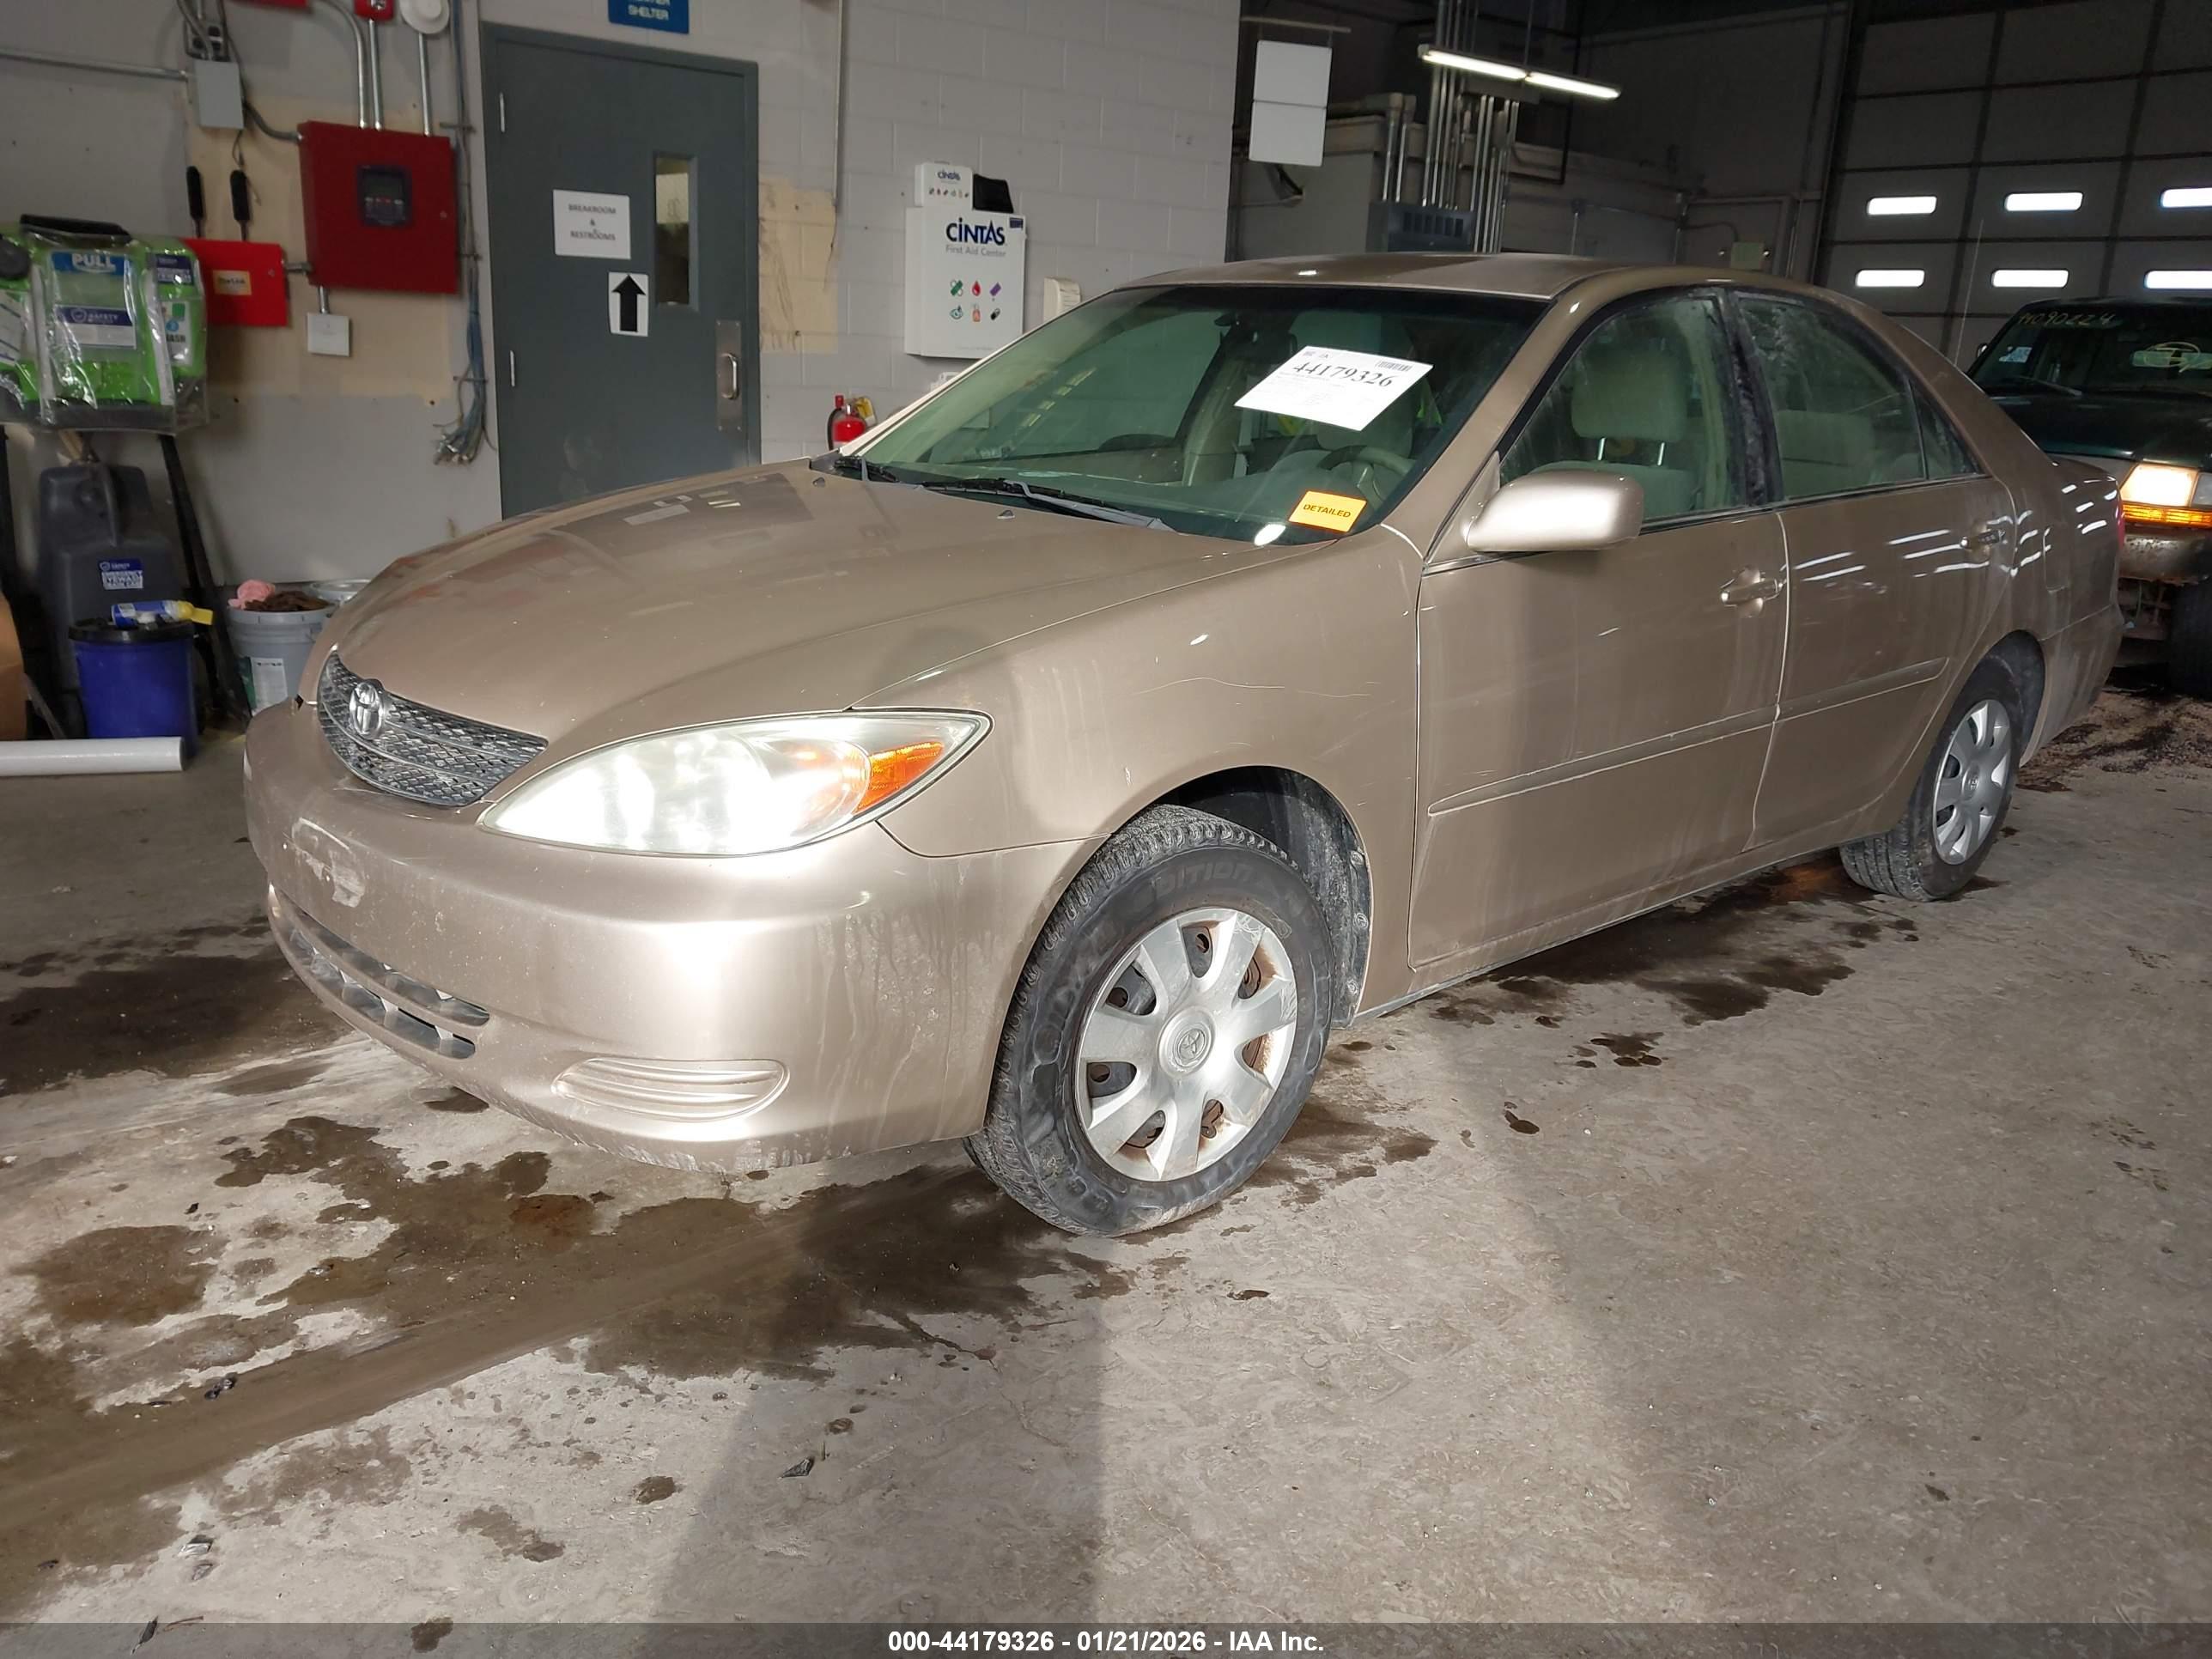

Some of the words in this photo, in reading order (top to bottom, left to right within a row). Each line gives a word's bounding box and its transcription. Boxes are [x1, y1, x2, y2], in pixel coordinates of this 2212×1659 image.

[568, 204, 617, 214] BREAKROOM
[570, 230, 617, 241] RESTROOMS
[945, 245, 963, 254] First
[965, 246, 979, 256] Aid
[981, 247, 1006, 258] Center
[71, 252, 117, 270] PULL
[1292, 361, 1398, 387] 44179326
[1303, 503, 1352, 518] DETAILED
